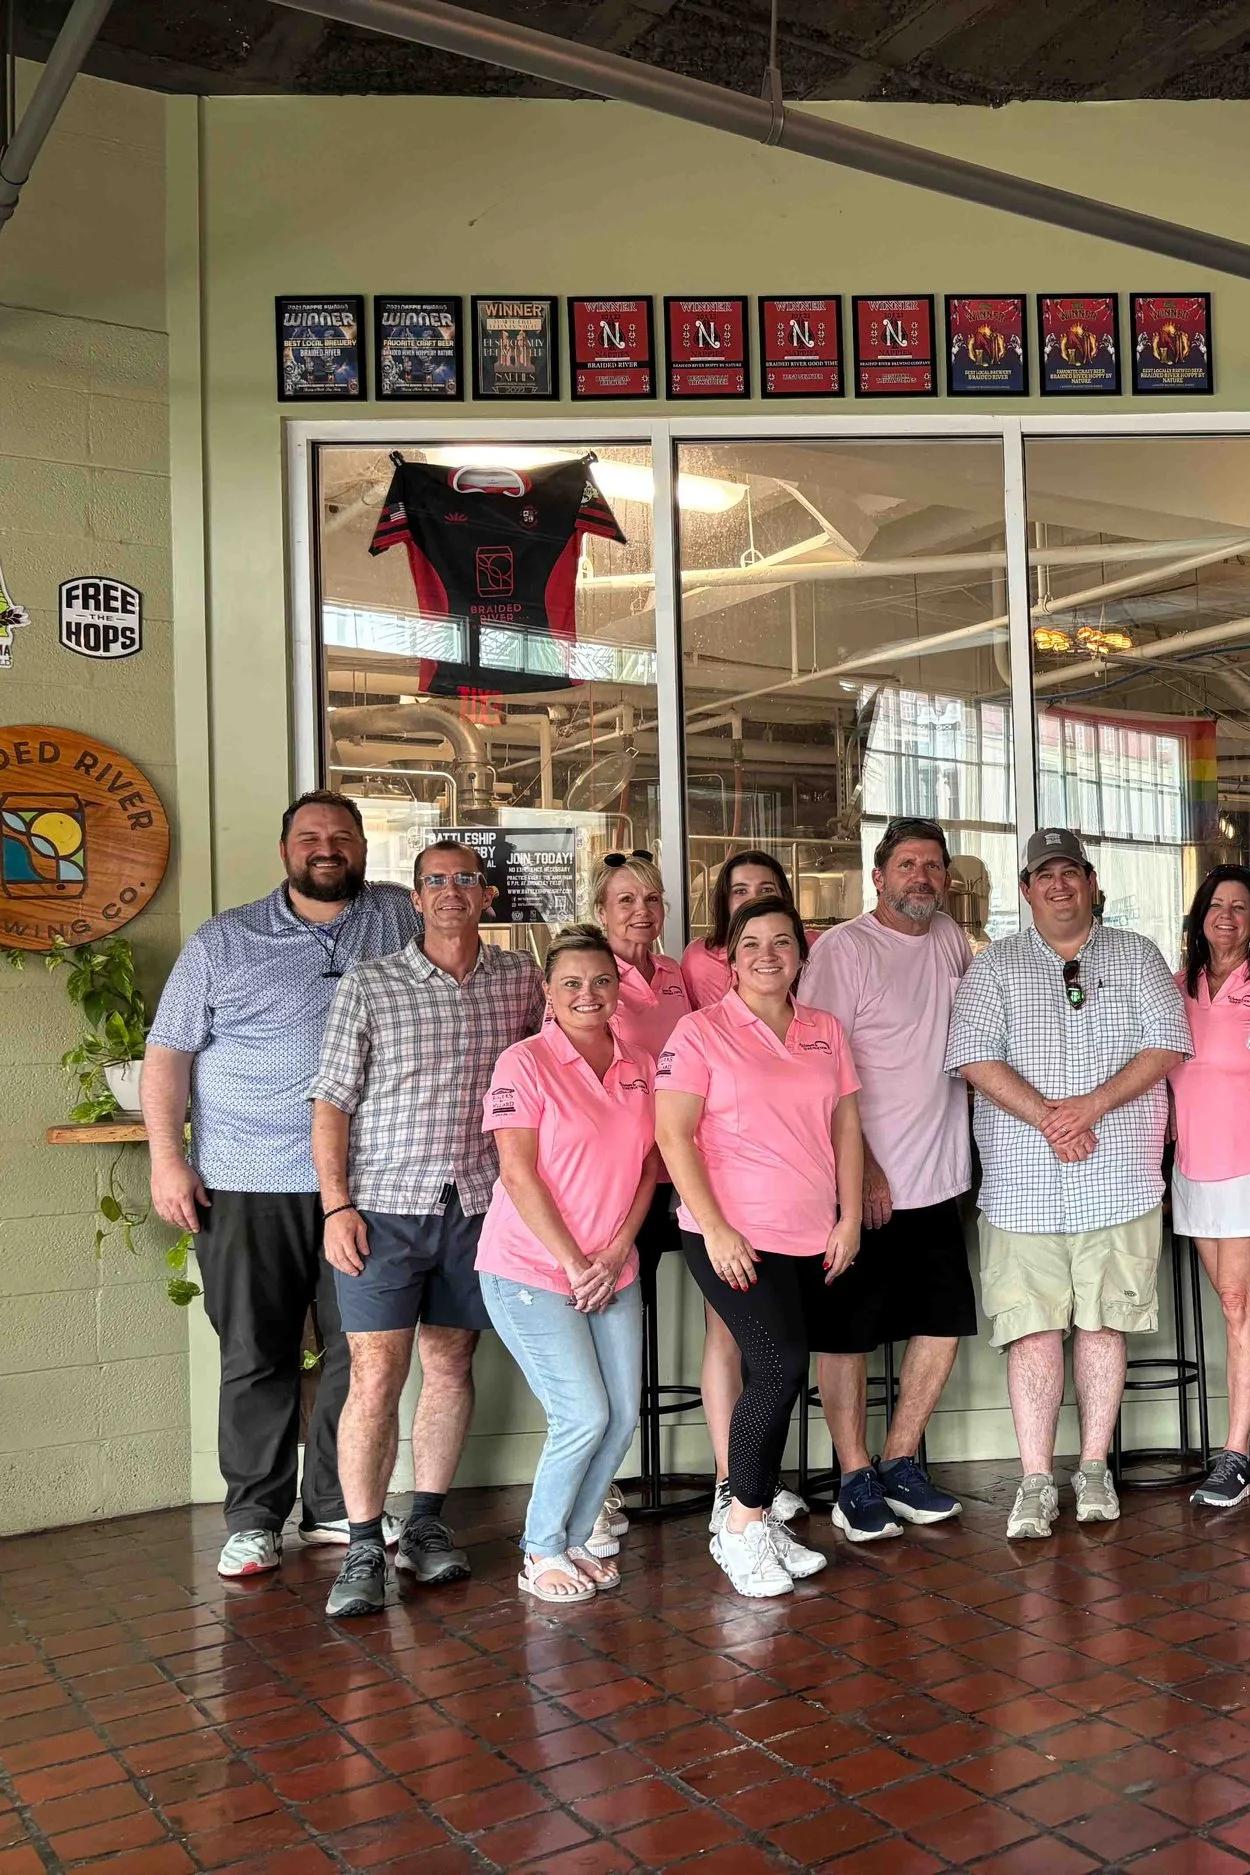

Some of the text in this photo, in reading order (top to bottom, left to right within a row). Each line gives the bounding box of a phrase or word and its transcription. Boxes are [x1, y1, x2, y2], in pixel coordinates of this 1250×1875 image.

[486, 304, 542, 317] WINNER
[584, 302, 638, 312] WINNER
[680, 302, 733, 312] WINNER
[774, 301, 827, 312] WINNER
[868, 301, 920, 311] WINNER
[284, 312, 356, 327] WINNER
[382, 312, 454, 327] WINNER
[967, 311, 1005, 322] WINNER
[600, 320, 626, 349] N
[696, 320, 720, 349] N
[790, 320, 815, 348] N
[883, 319, 908, 347] N
[300, 349, 323, 357] BRAIDED
[66, 583, 136, 615] FREE
[470, 604, 522, 614] BRAIDED
[480, 613, 514, 623] RIVER
[66, 621, 136, 653] HOPS
[74, 750, 153, 830] RIVER
[429, 832, 496, 845] BATTLESHIP
[506, 852, 573, 865] JOIN TODAY!
[102, 882, 146, 920] CO.
